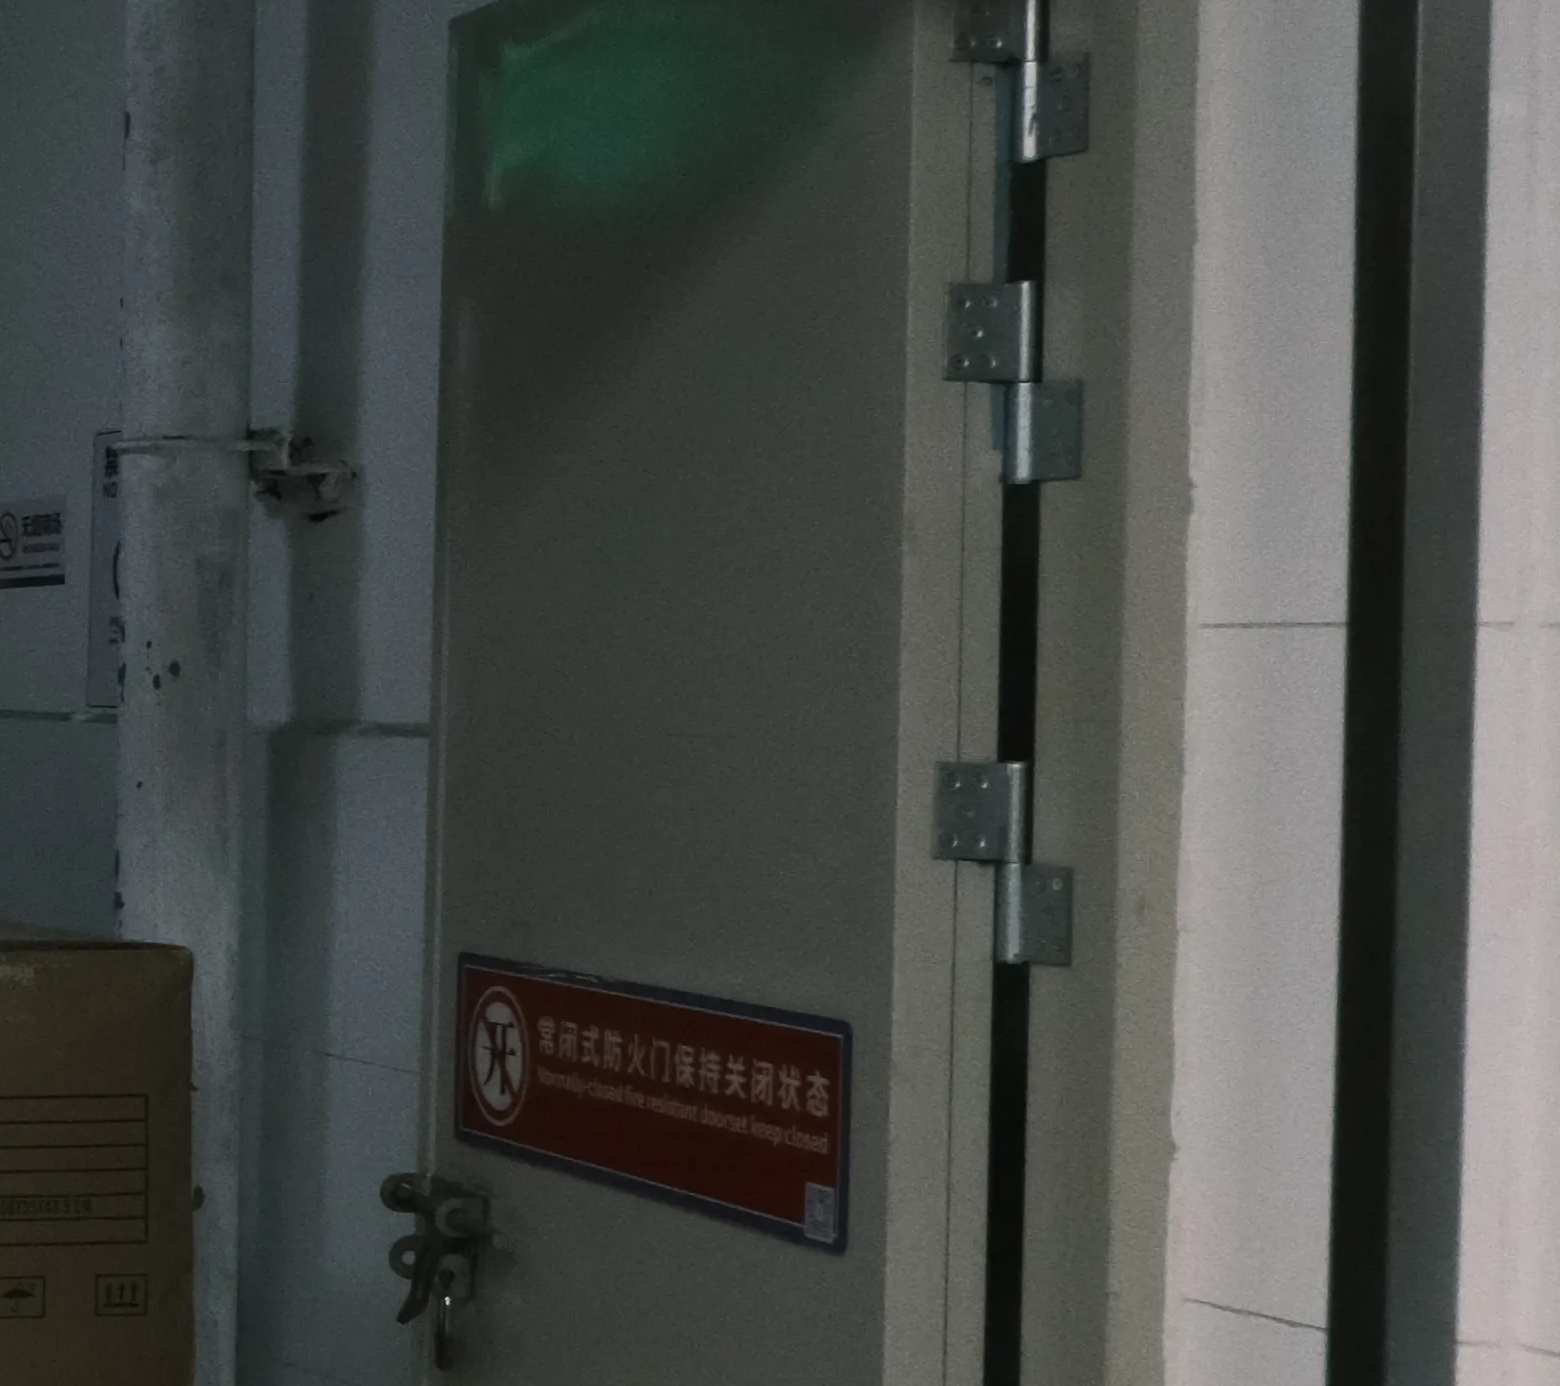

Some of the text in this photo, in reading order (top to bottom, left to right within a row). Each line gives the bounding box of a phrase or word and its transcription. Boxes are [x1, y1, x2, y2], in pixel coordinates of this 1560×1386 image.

[536, 1014, 830, 1117] 常闭式防火门保持关闭状态
